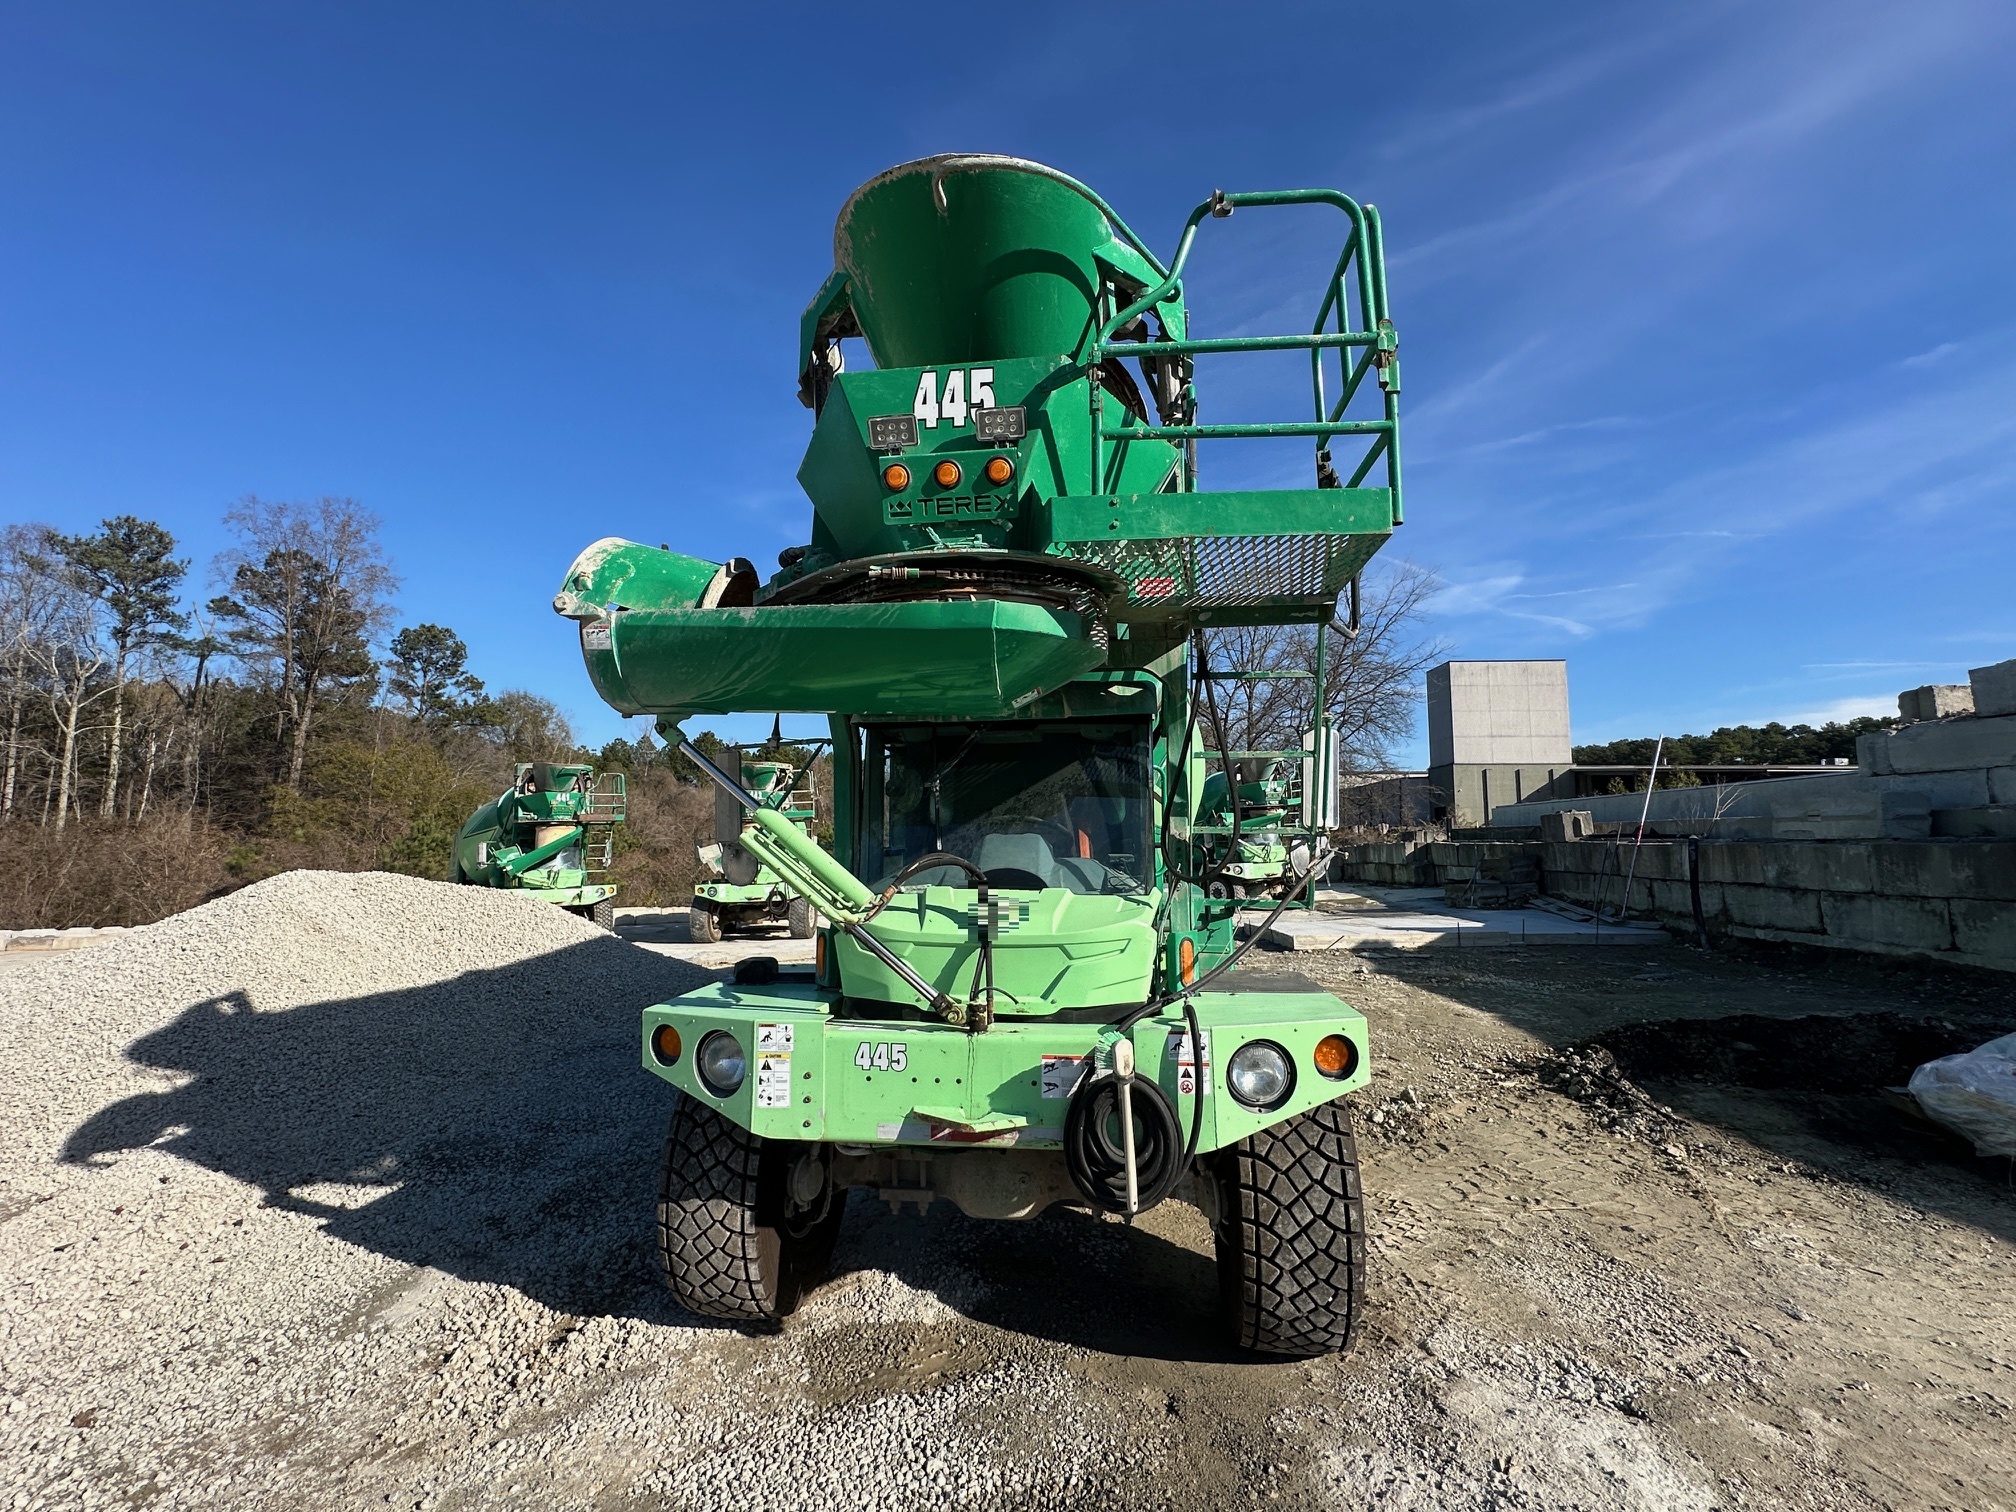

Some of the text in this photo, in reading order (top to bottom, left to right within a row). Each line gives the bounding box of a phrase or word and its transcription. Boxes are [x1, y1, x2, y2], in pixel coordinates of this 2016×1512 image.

[914, 367, 996, 429] 445
[917, 495, 1013, 515] TEREX
[855, 1041, 907, 1072] 445
